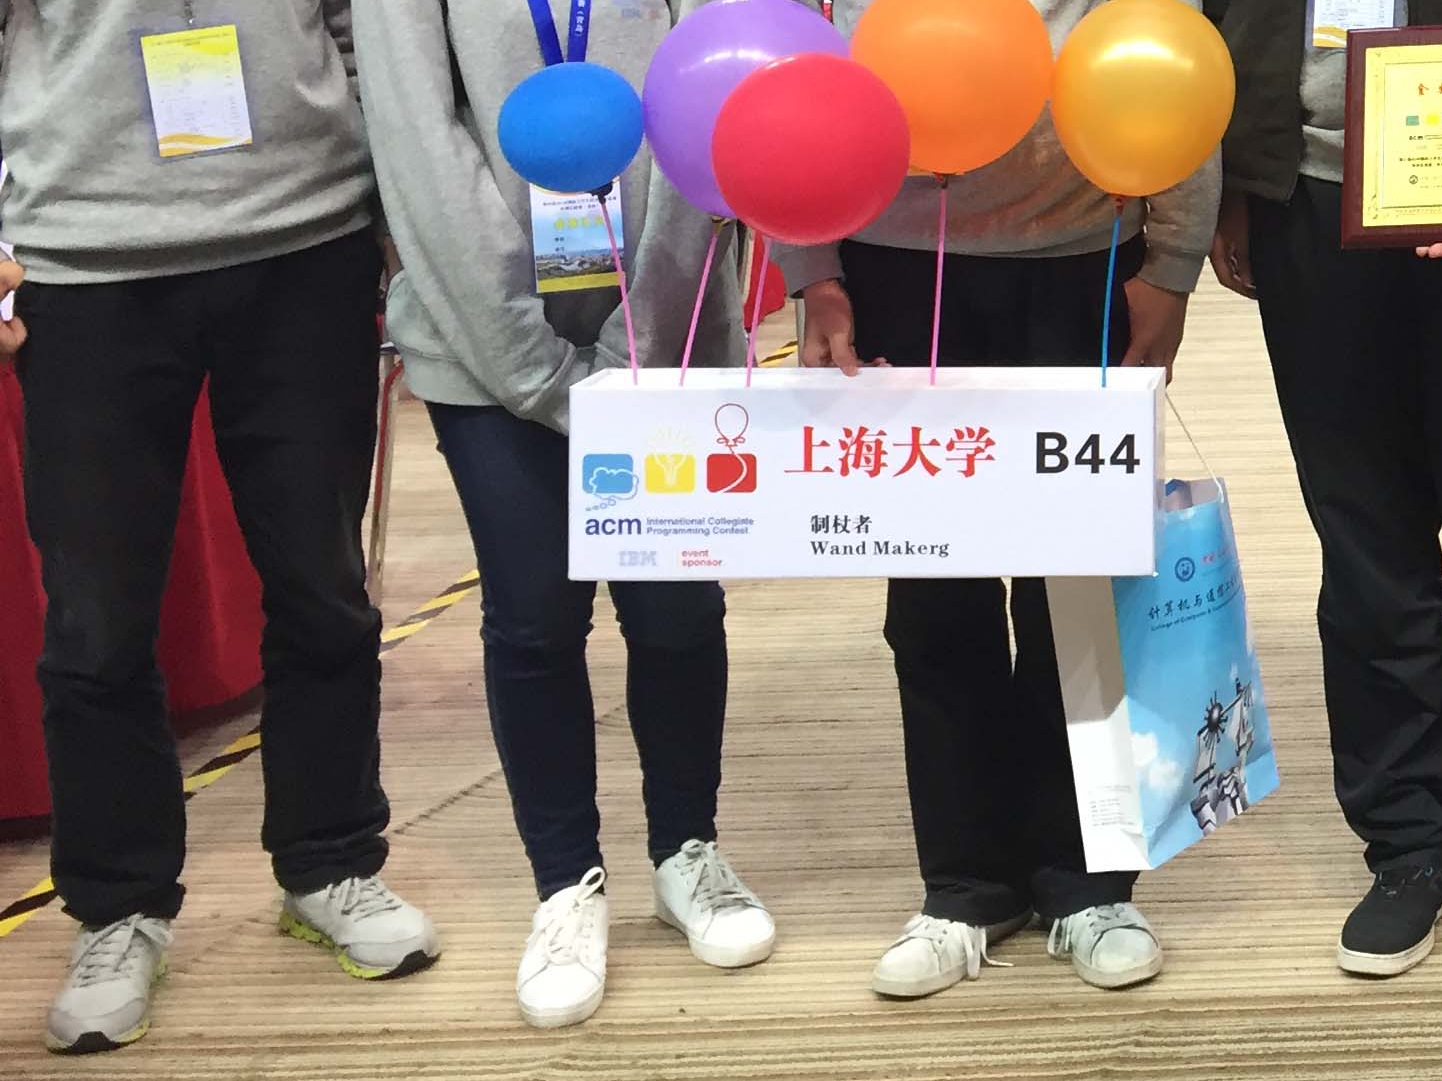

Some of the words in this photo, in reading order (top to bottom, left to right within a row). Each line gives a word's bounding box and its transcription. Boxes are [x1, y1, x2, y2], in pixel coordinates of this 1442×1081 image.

[784, 425, 995, 479] 上海大学
[1035, 431, 1141, 475] B44
[585, 518, 642, 535] acm
[647, 517, 705, 526] International
[709, 517, 754, 527] Collegiate
[810, 515, 873, 535] 制杖者
[647, 527, 710, 536] Programming
[712, 527, 749, 535] Contest
[618, 550, 657, 567] IBM
[810, 541, 867, 556] Wand
[873, 541, 950, 559] Makerg
[682, 558, 722, 567] sponsor
